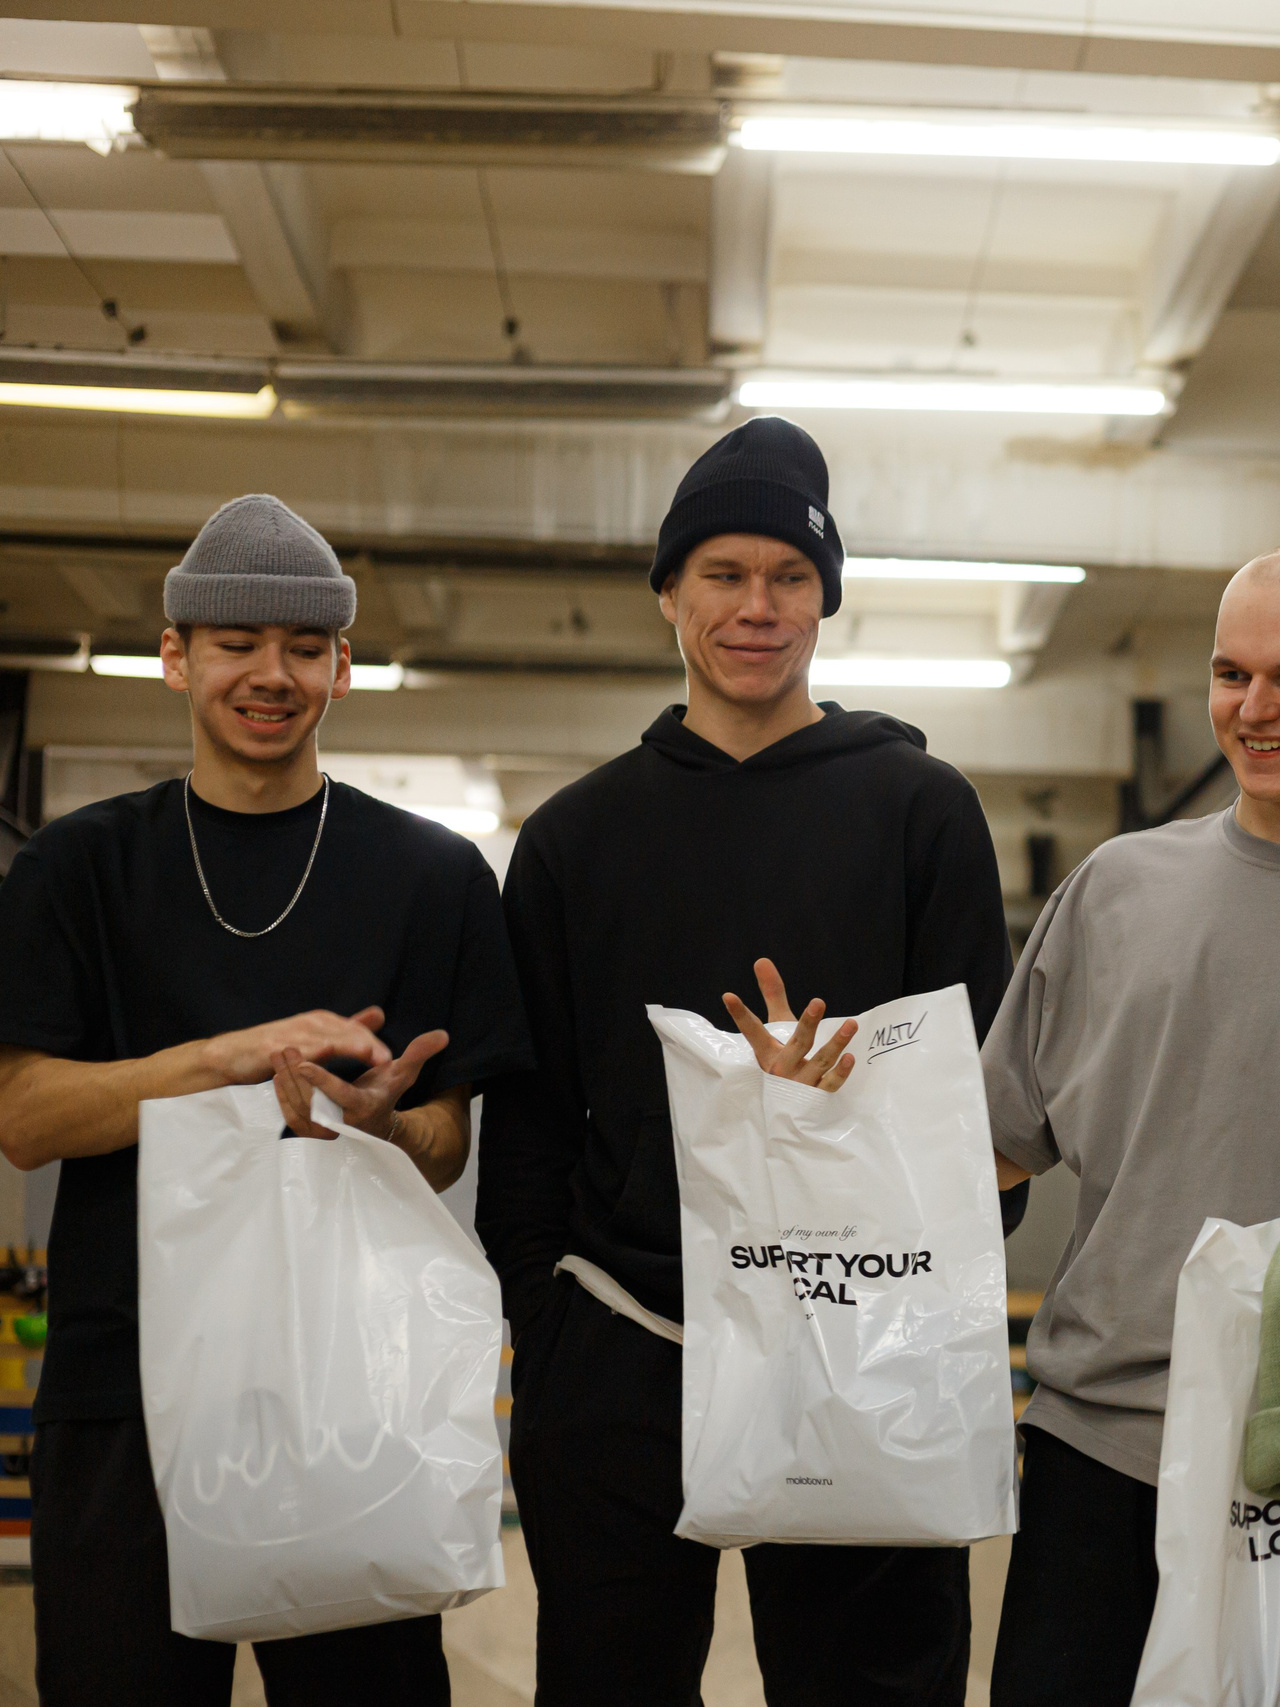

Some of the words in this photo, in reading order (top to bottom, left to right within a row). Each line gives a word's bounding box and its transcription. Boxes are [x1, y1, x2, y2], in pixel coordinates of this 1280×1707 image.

[780, 1225, 798, 1240] of
[795, 1228, 813, 1241] my
[839, 1225, 858, 1241] life
[730, 1244, 832, 1276] SUPRT
[834, 1250, 933, 1279] YOUR
[793, 1276, 858, 1306] CAL
